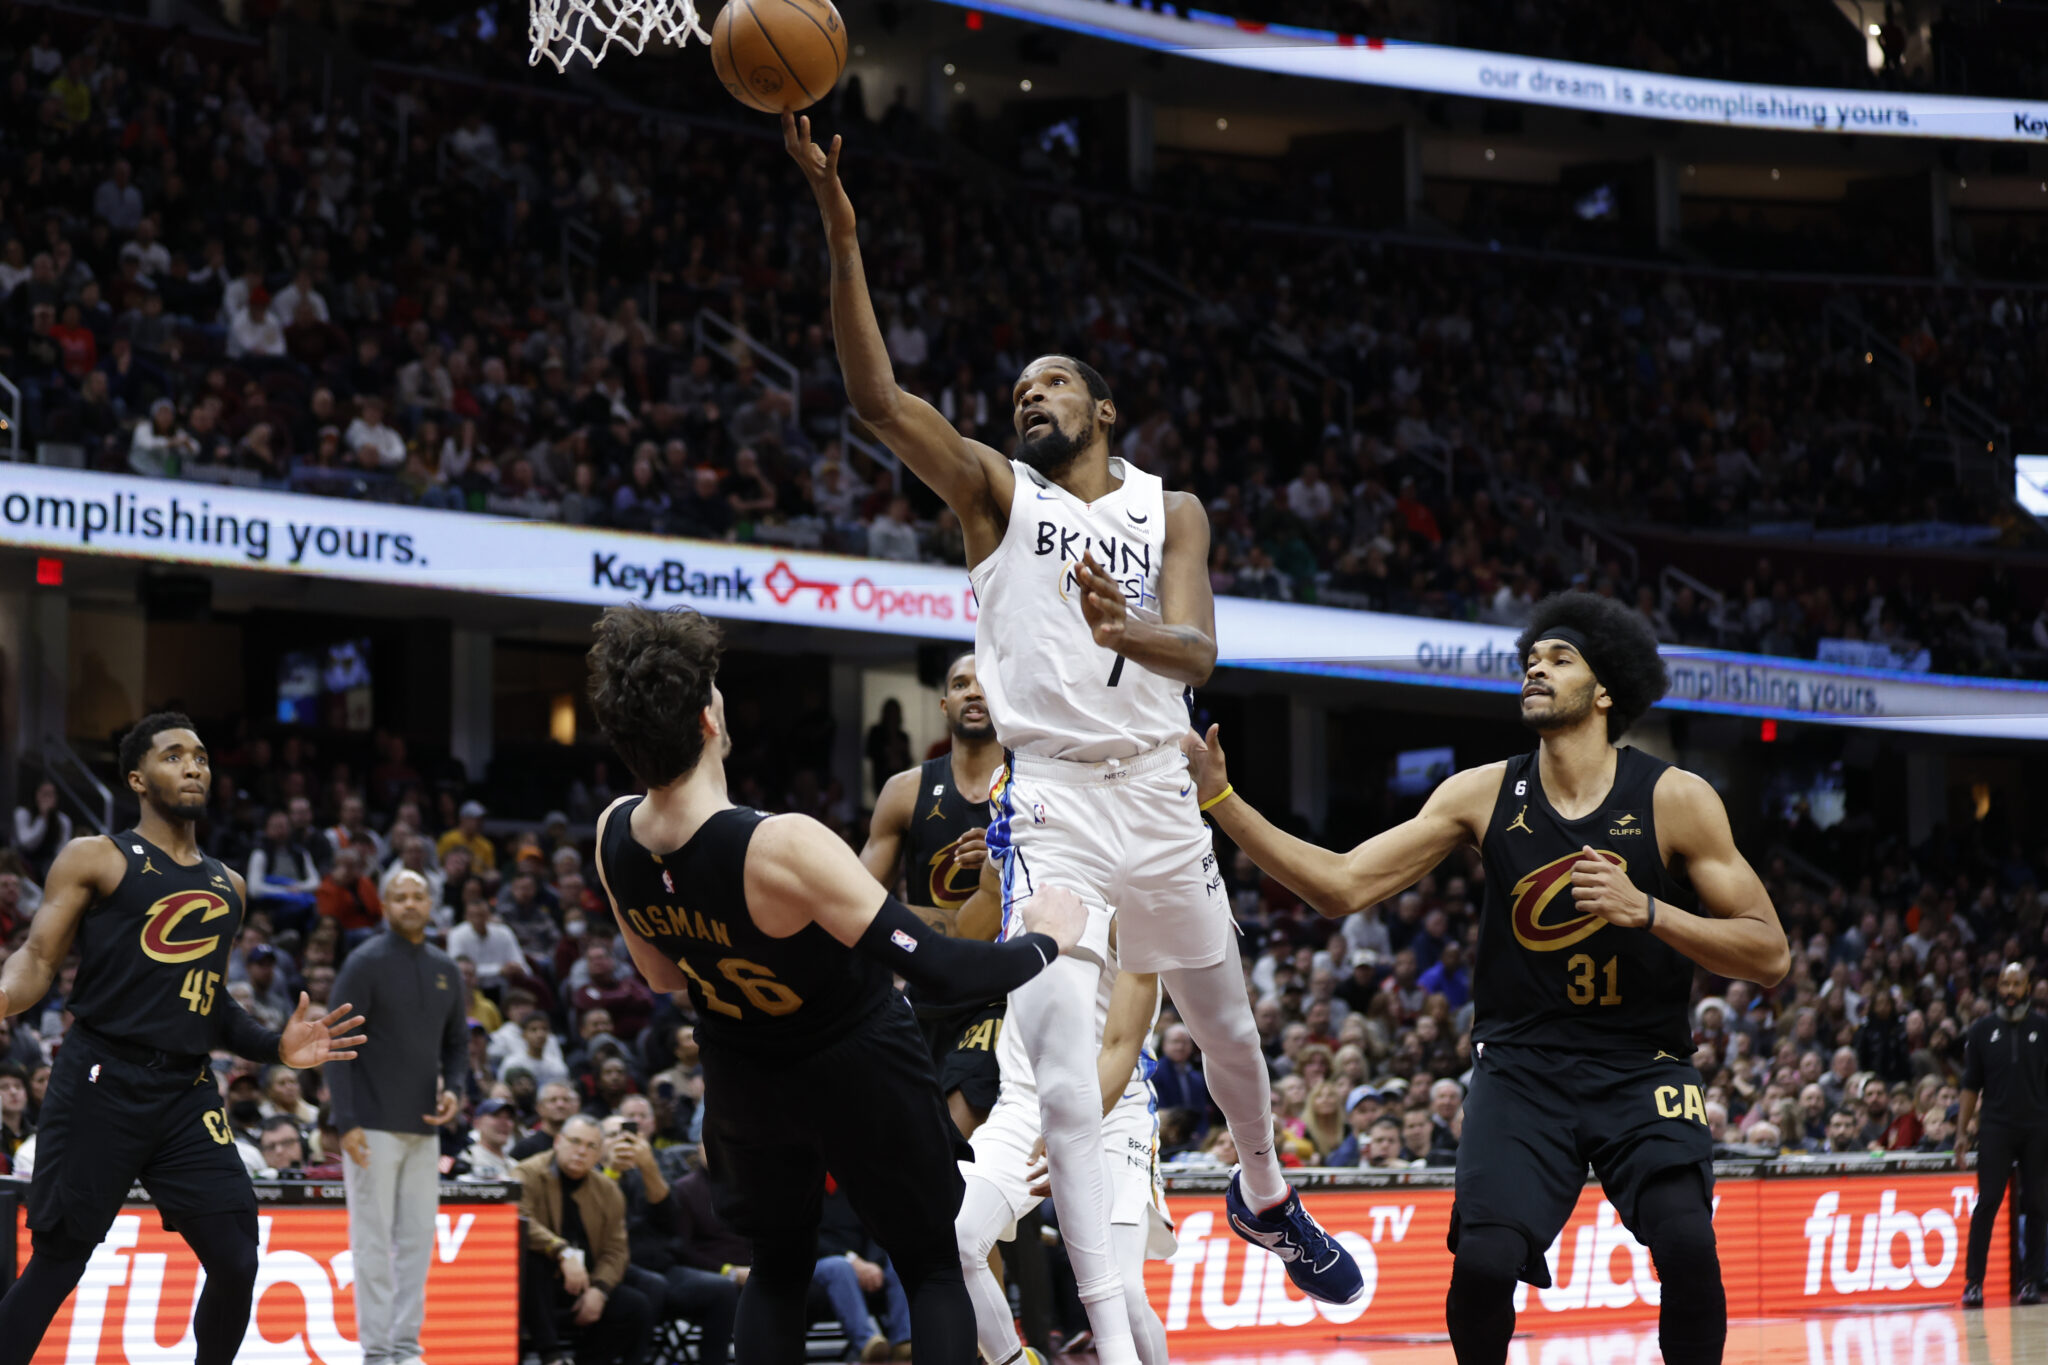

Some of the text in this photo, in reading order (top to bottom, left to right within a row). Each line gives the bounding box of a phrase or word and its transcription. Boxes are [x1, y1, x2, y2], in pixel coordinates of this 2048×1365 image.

[1479, 65, 1918, 129] our dream is accomplishing yours.
[288, 522, 429, 567] yours.
[591, 551, 755, 602] KeyBank
[851, 577, 954, 620] Opens
[1417, 641, 1464, 669] our
[932, 784, 944, 796] 6
[1104, 769, 1127, 781] NETS
[1515, 780, 1527, 796] 6
[1609, 828, 1642, 836] CLIFFS
[627, 904, 733, 948] OSMAN
[179, 968, 221, 1016] 45
[677, 957, 804, 1020] 16
[1567, 953, 1622, 1006] 31
[1370, 1205, 1415, 1243] TV
[1804, 1189, 1958, 1295] fubo
